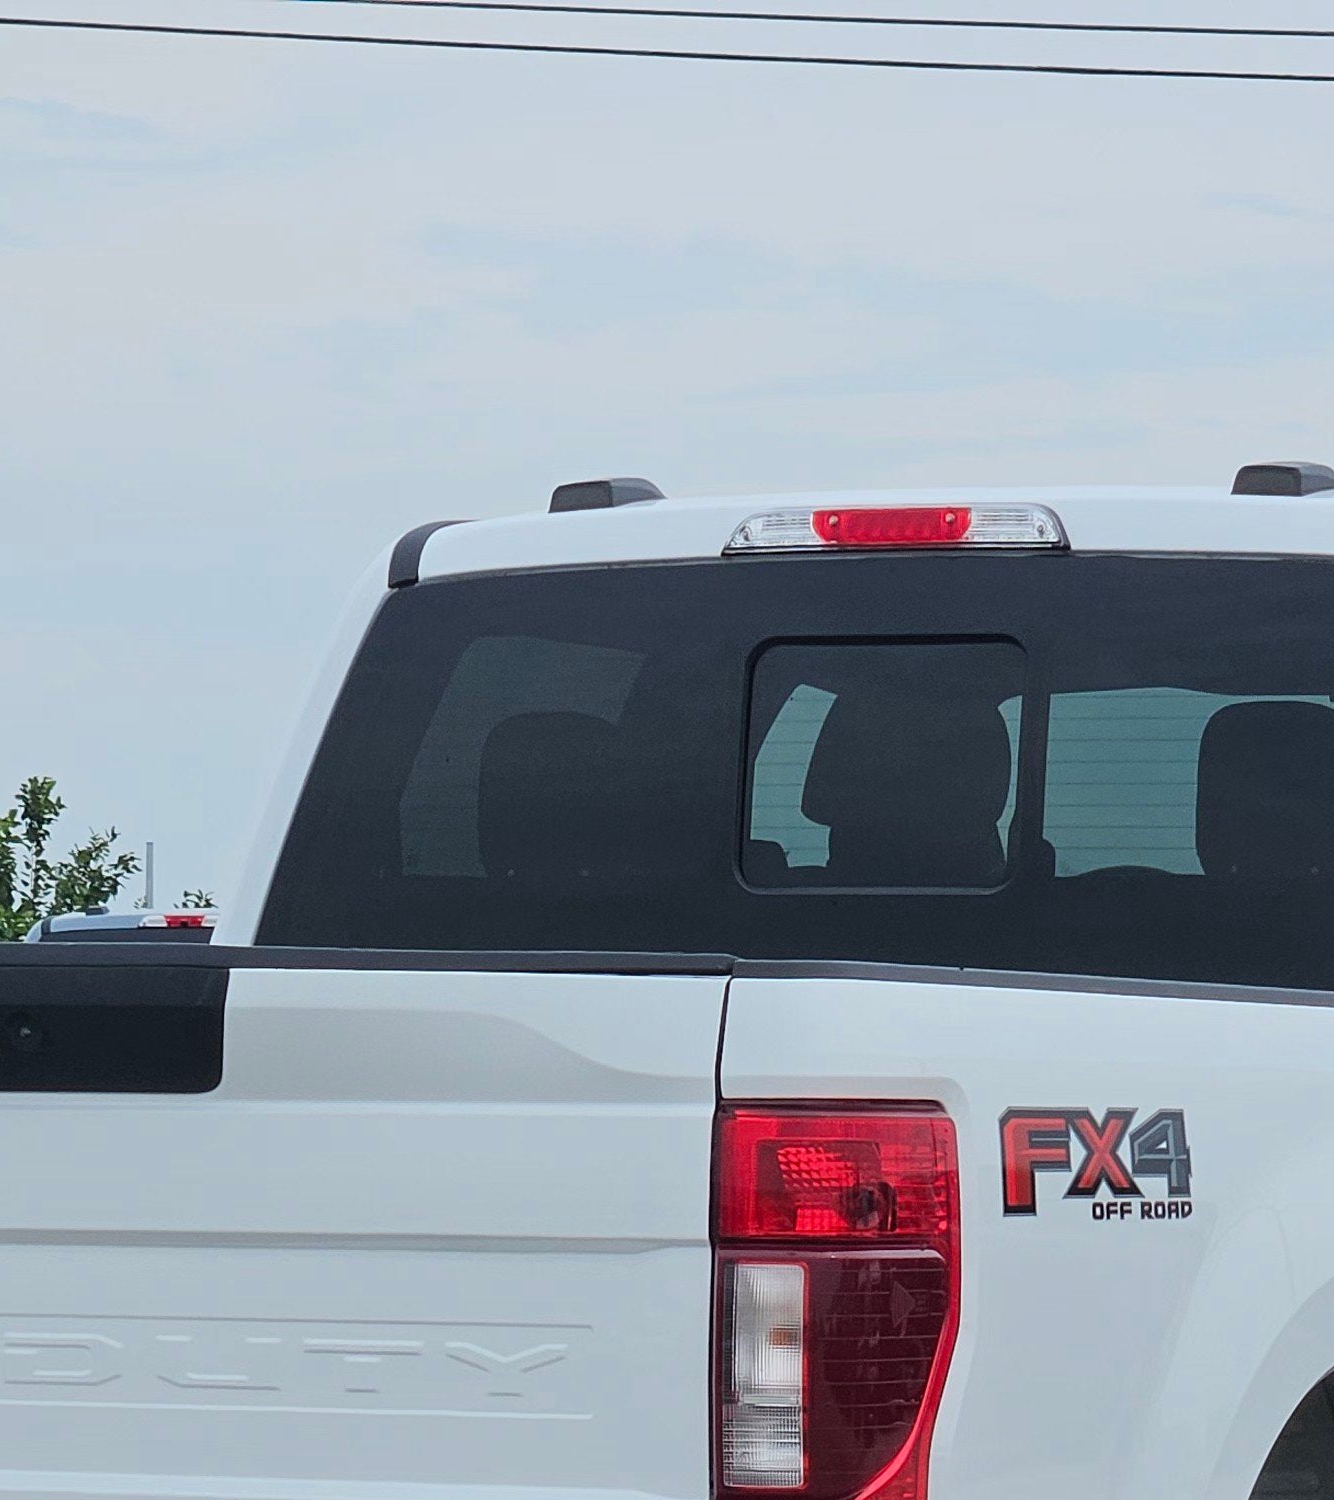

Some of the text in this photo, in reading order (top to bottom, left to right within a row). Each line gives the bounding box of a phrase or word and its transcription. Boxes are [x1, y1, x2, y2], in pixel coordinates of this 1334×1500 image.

[998, 1106, 1192, 1217] FX4
[1092, 1201, 1193, 1220] OFF ROAD
[3, 1332, 567, 1397] DUTY
